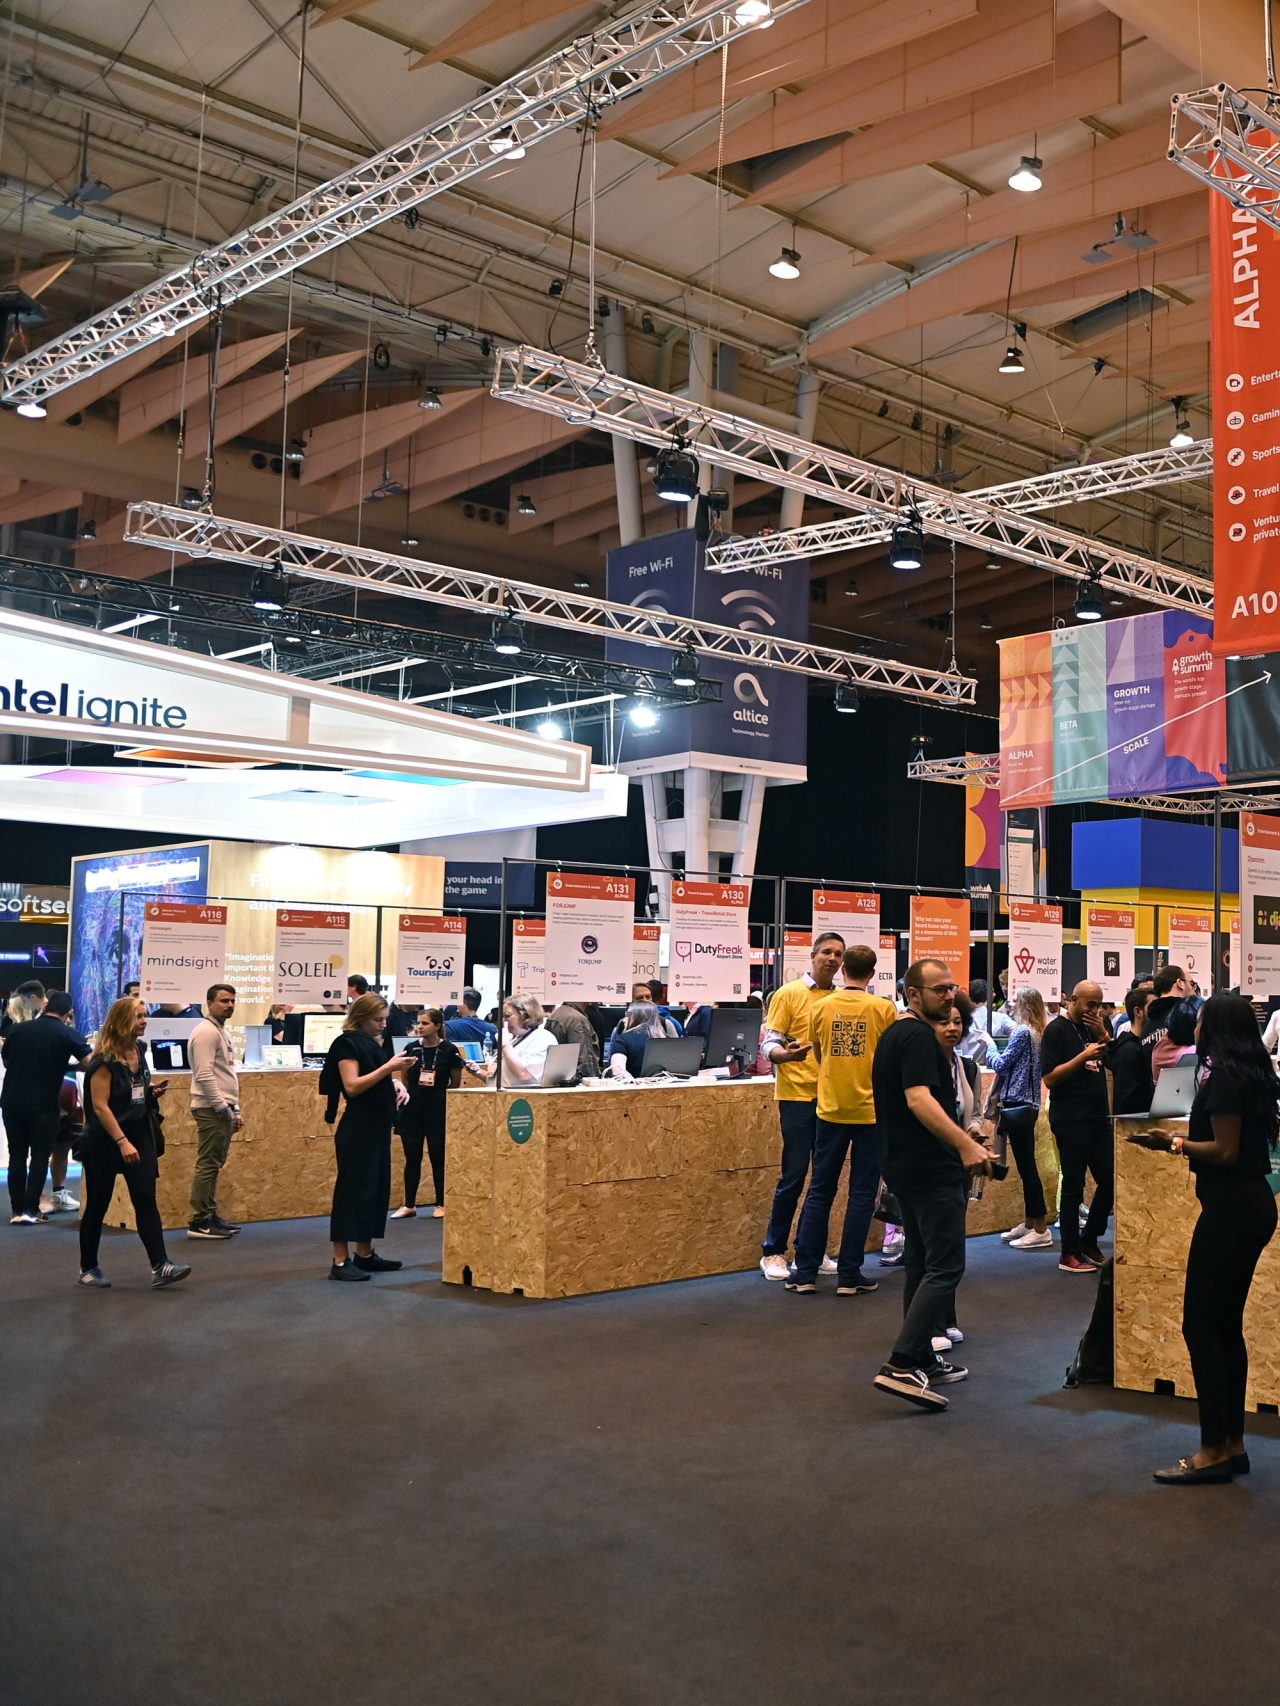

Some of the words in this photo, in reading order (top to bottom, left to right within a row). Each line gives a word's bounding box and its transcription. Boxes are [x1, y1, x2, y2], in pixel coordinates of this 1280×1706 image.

[1232, 191, 1260, 329] ALPHA
[1253, 484, 1280, 499] Travel
[629, 565, 648, 578] Free
[650, 556, 674, 573] Wi-Fi
[754, 565, 783, 581] Wi-Fi
[1180, 651, 1213, 667] growth
[1180, 662, 1214, 675] summit
[1113, 685, 1151, 699] GROWTH
[77, 690, 188, 729] ignite
[733, 708, 769, 725] altice
[1059, 720, 1078, 730] BETA
[1123, 736, 1150, 755] SCALE
[1008, 750, 1034, 761] ALPHA
[446, 877, 467, 885] your
[469, 876, 492, 884] head
[461, 887, 488, 895] game
[606, 883, 629, 894] A131
[721, 890, 744, 900] A130
[200, 910, 222, 920] A116
[326, 916, 346, 924] A115
[443, 921, 462, 929] A114
[642, 929, 658, 937] A112
[694, 943, 743, 958] DutyFreak
[147, 955, 220, 970] mindsight
[1037, 957, 1057, 965] water
[278, 961, 337, 978] SOLEIL
[1036, 967, 1058, 975] melon
[224, 975, 272, 984] Knowledge
